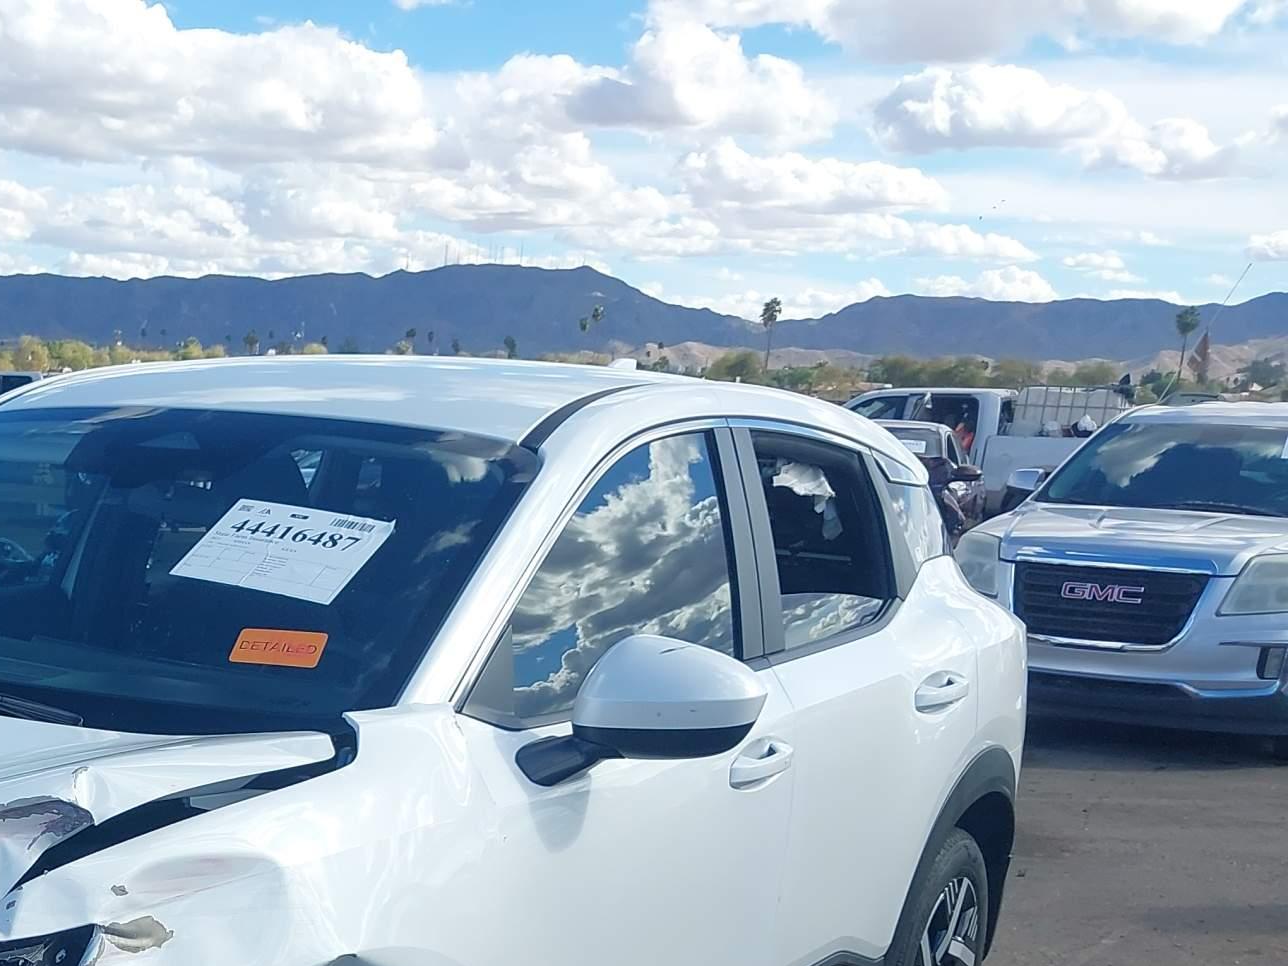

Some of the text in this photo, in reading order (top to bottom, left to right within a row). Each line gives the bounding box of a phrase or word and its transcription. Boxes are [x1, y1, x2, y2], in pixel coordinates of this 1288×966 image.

[230, 519, 361, 552] 44416487
[1060, 581, 1145, 604] GMC
[239, 640, 317, 655] DETAILED
